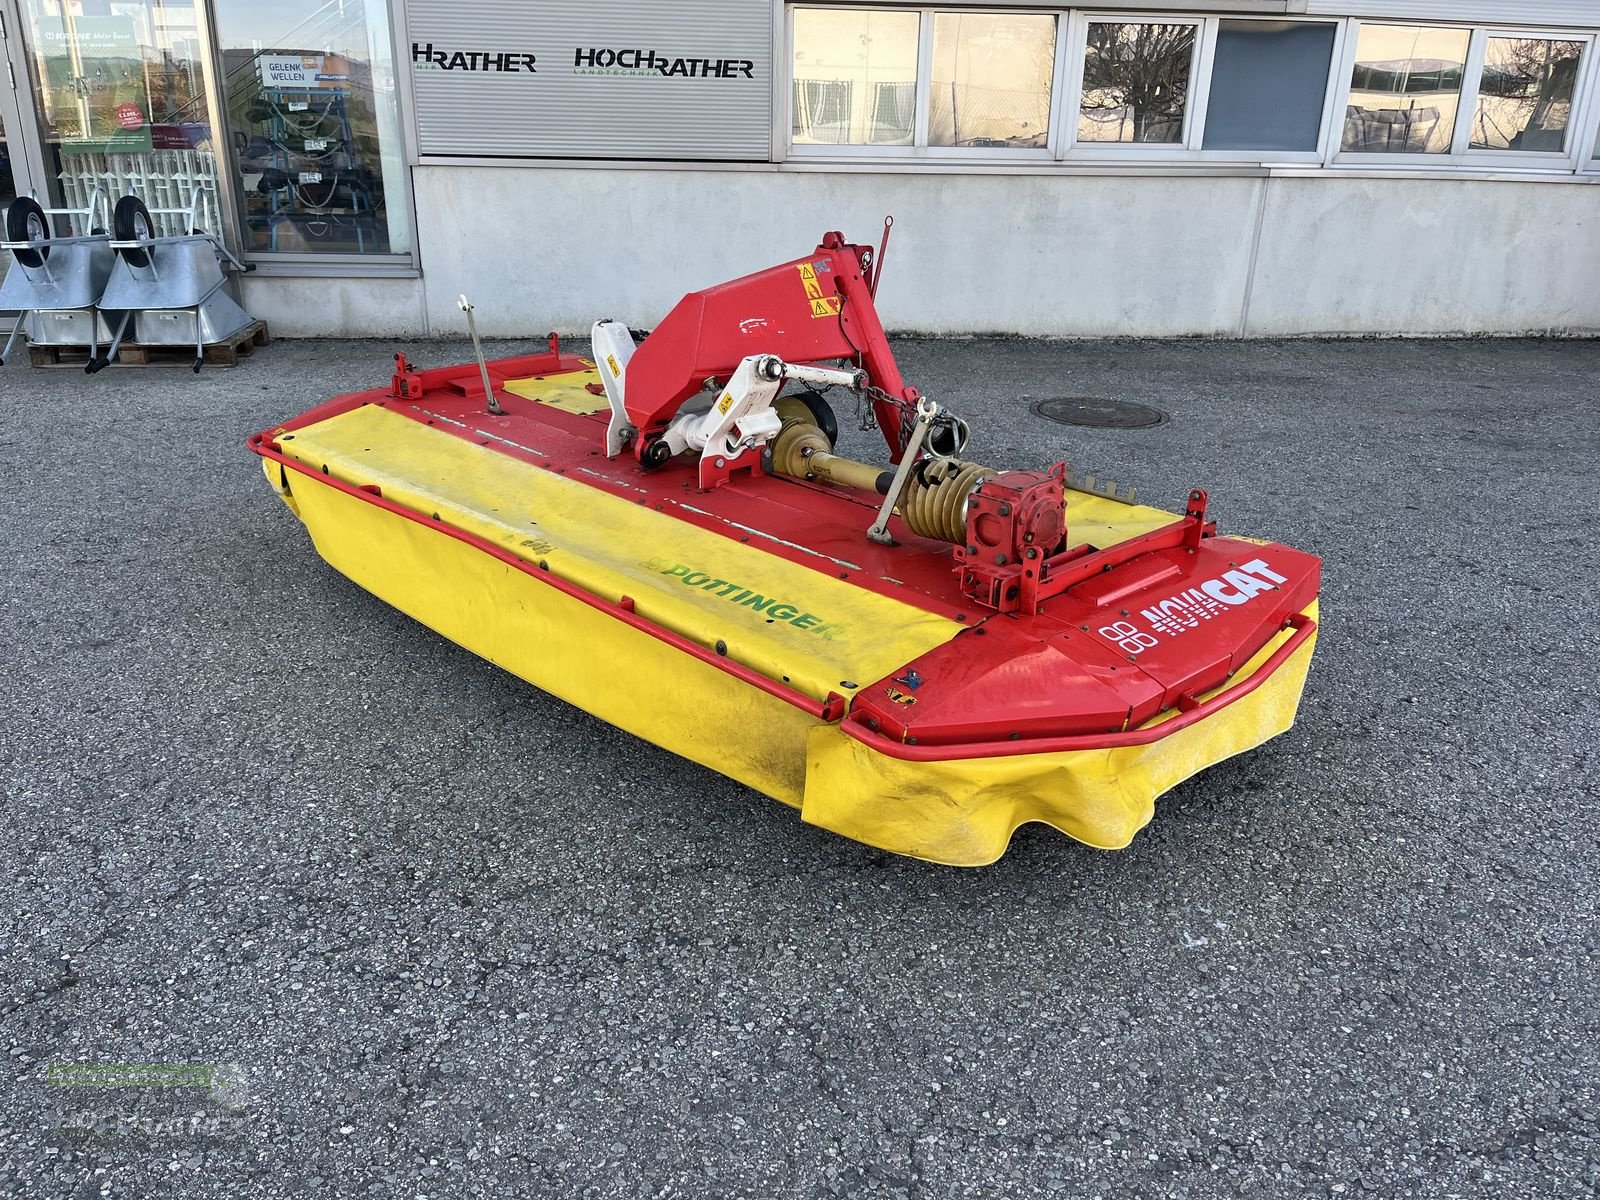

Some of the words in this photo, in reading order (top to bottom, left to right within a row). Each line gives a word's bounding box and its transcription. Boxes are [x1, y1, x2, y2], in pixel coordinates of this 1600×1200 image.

[412, 43, 537, 73] HRATHER
[269, 63, 301, 72] GELENK
[575, 48, 754, 79] HOCHRATHER
[271, 73, 305, 81] WELLEN
[573, 69, 658, 77] LANDTECHNIK
